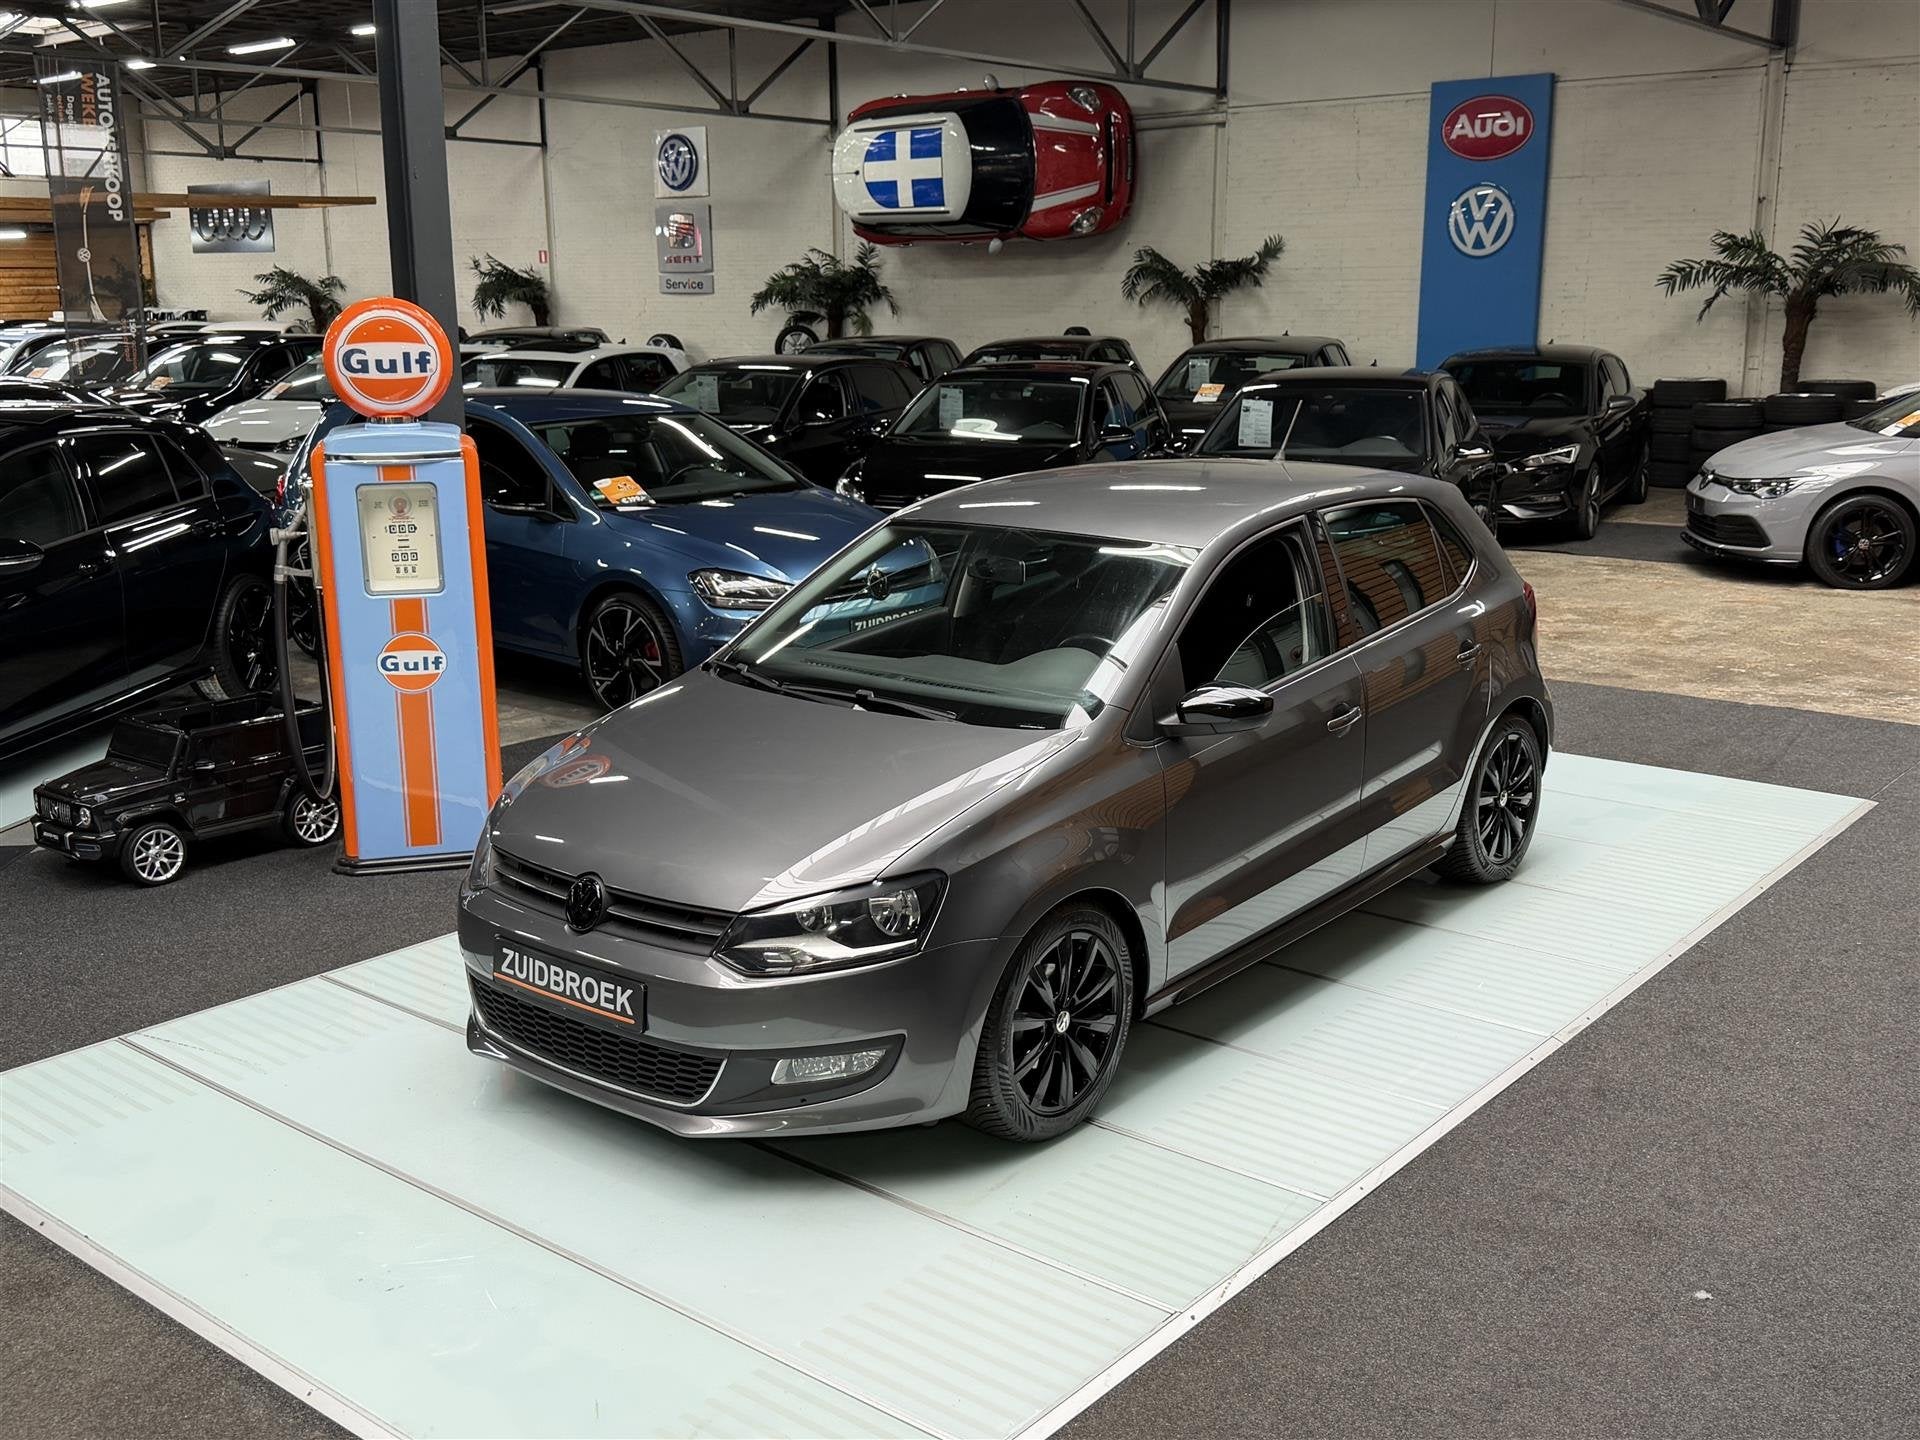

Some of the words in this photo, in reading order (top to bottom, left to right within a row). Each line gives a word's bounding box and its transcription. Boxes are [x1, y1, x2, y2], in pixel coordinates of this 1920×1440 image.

[81, 72, 97, 126] WEKE
[1450, 110, 1525, 140] Audi
[1448, 185, 1515, 258] VW
[664, 255, 702, 264] SEAT
[665, 278, 704, 290] Service
[342, 348, 432, 374] Gulf
[381, 655, 443, 672] Gulf
[501, 947, 634, 1016] ZUIDBROEK
